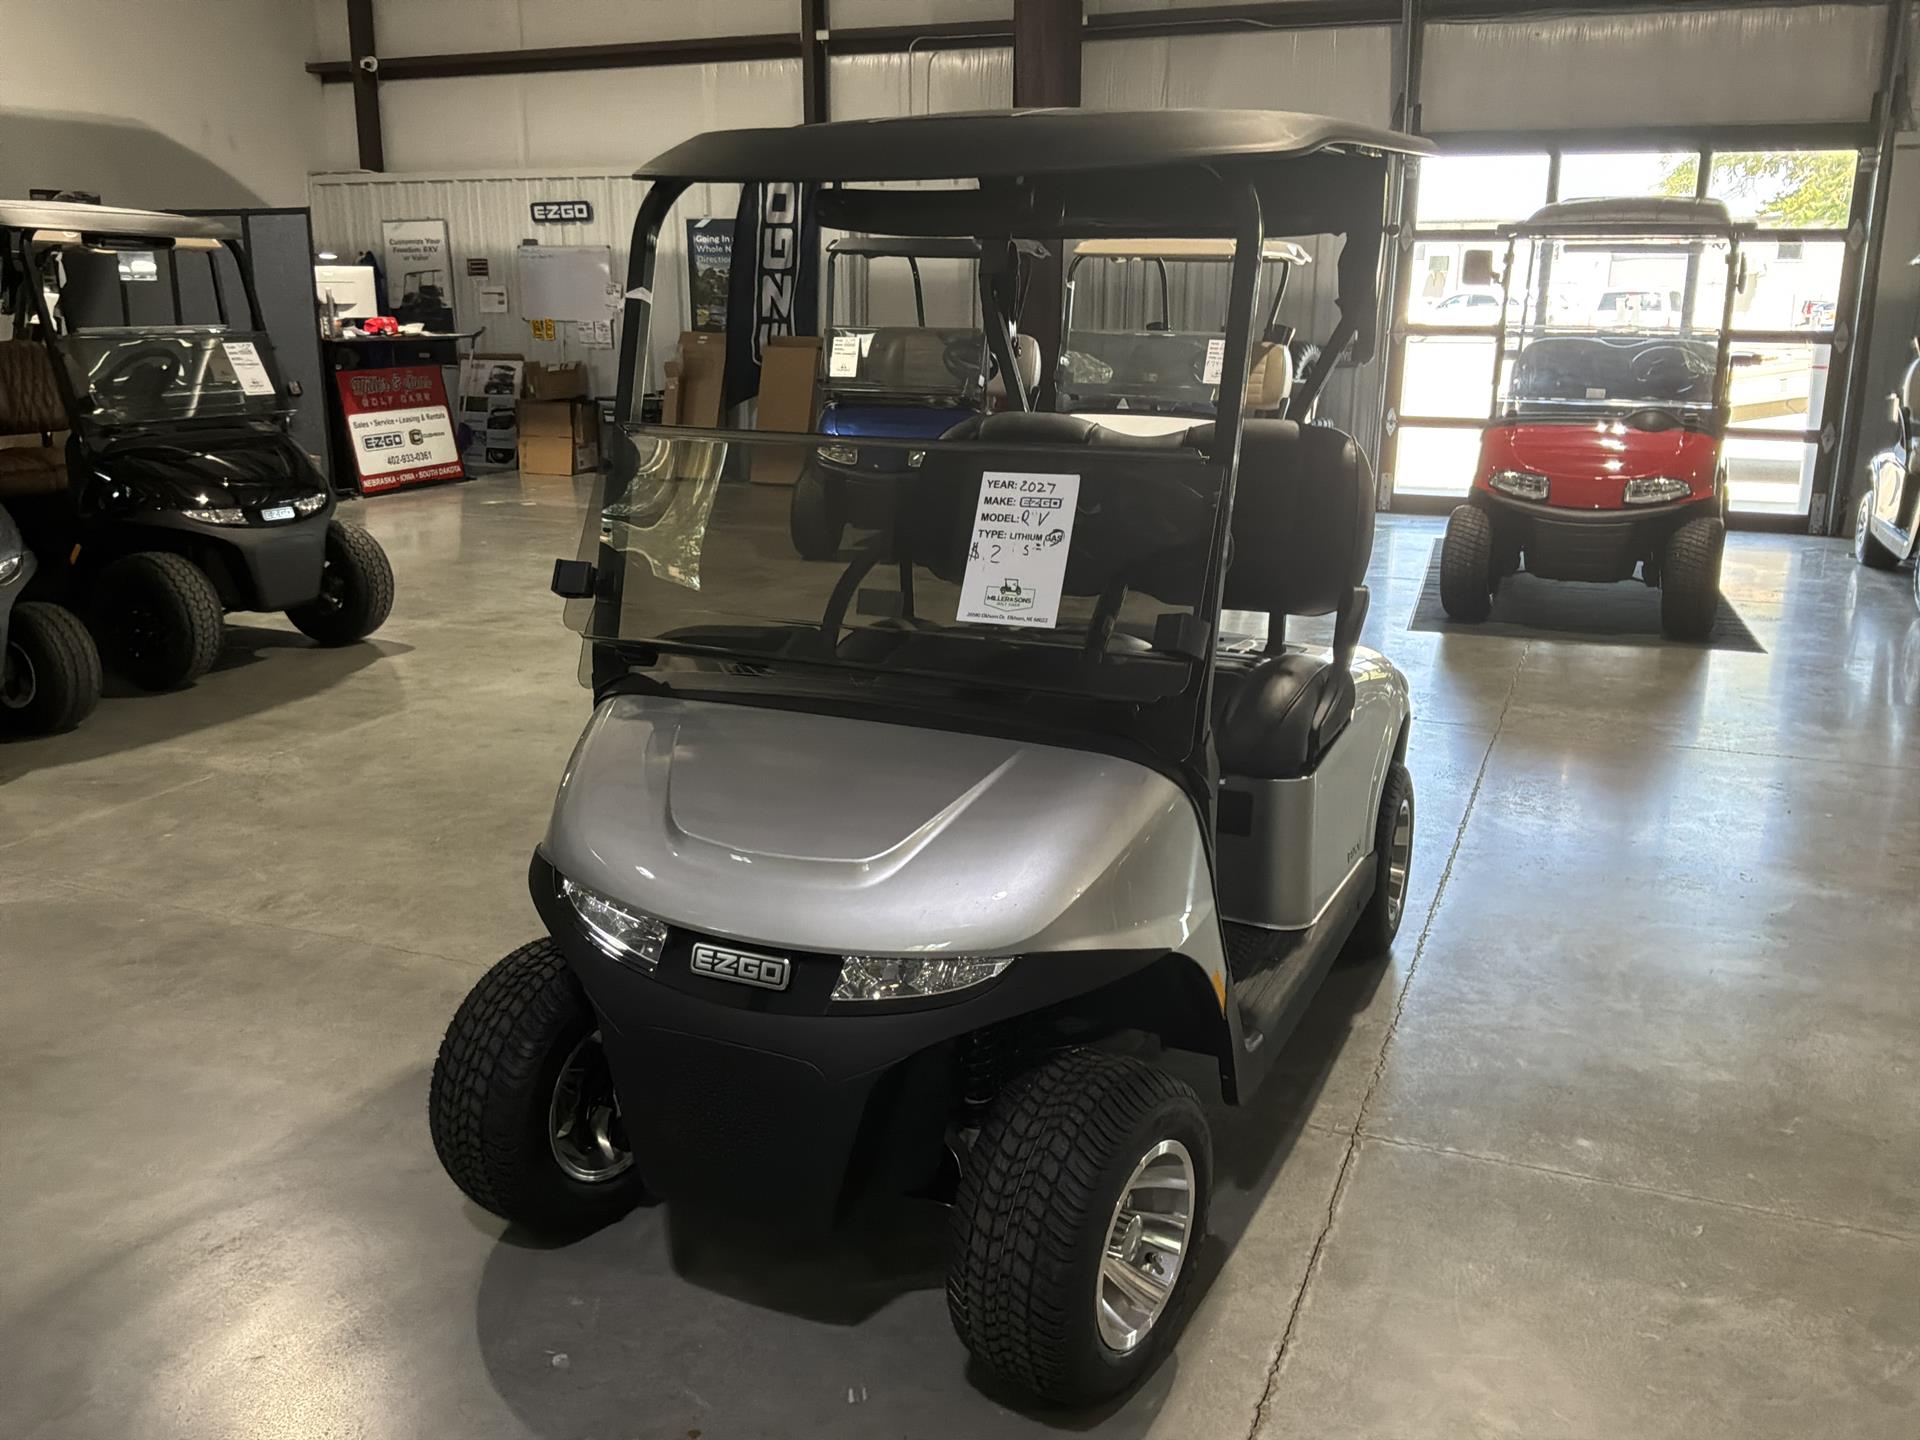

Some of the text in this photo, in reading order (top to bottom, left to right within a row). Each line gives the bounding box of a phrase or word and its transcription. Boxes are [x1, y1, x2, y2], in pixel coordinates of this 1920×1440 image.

[695, 234, 720, 244] Going
[721, 234, 730, 243] In
[696, 245, 723, 253] Whole
[353, 421, 369, 429] Sales
[373, 418, 395, 428] Service
[399, 415, 421, 424] Leasing
[426, 412, 446, 421] Rentals
[362, 465, 462, 487] NEBRASKA IOWA SOUTH DAKOTA
[987, 479, 1018, 490] YEAR:
[983, 495, 1017, 507] MAKE:
[980, 509, 1051, 527] MODEL: RV
[977, 529, 1007, 540] TYPE:
[1009, 532, 1043, 541] LITHIUM
[986, 594, 1010, 603] MILLER
[1014, 596, 1032, 604] SONS
